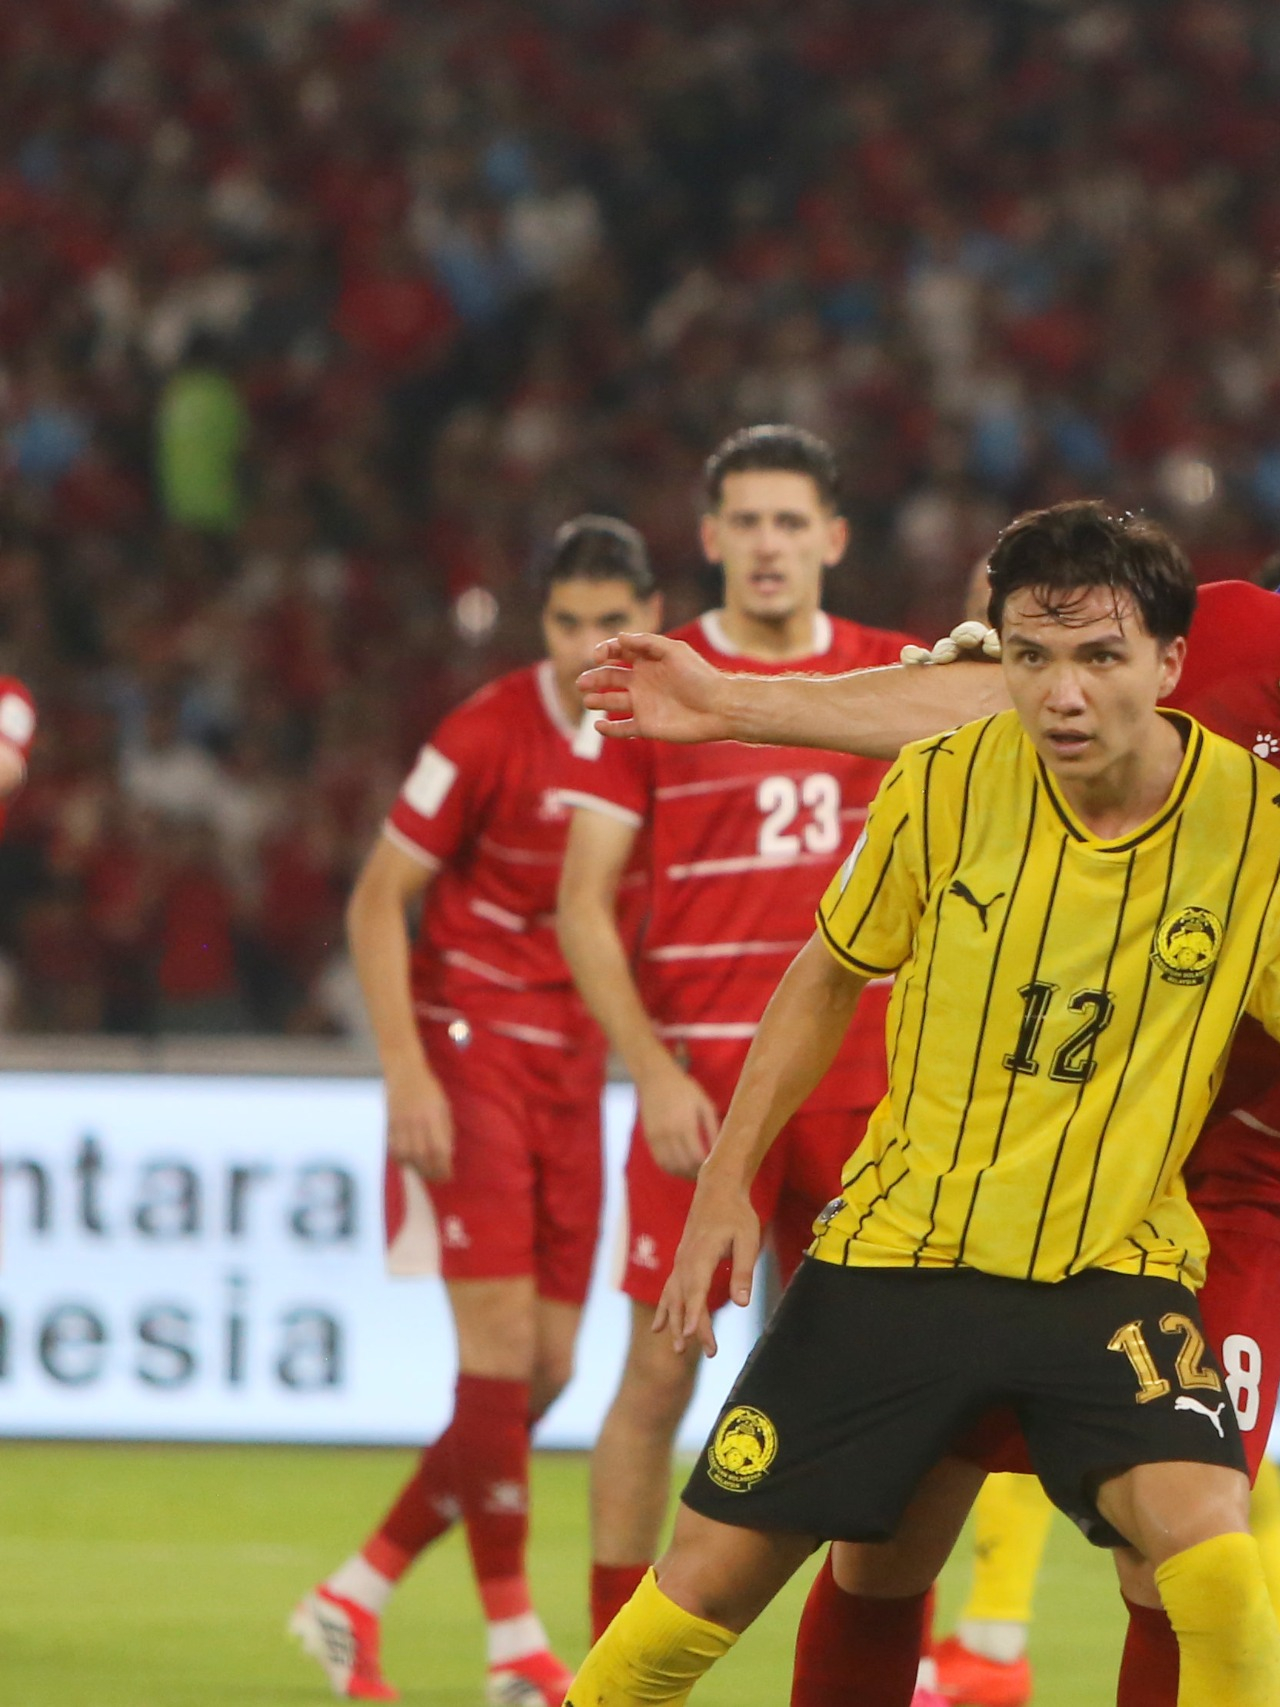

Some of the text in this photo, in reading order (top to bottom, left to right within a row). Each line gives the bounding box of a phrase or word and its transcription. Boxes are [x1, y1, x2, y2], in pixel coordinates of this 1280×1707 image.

[757, 773, 842, 856] 23
[1002, 980, 1115, 1084] 12
[0, 1274, 343, 1389] esia
[1106, 1312, 1222, 1405] 12
[1222, 1334, 1262, 1432] 8
